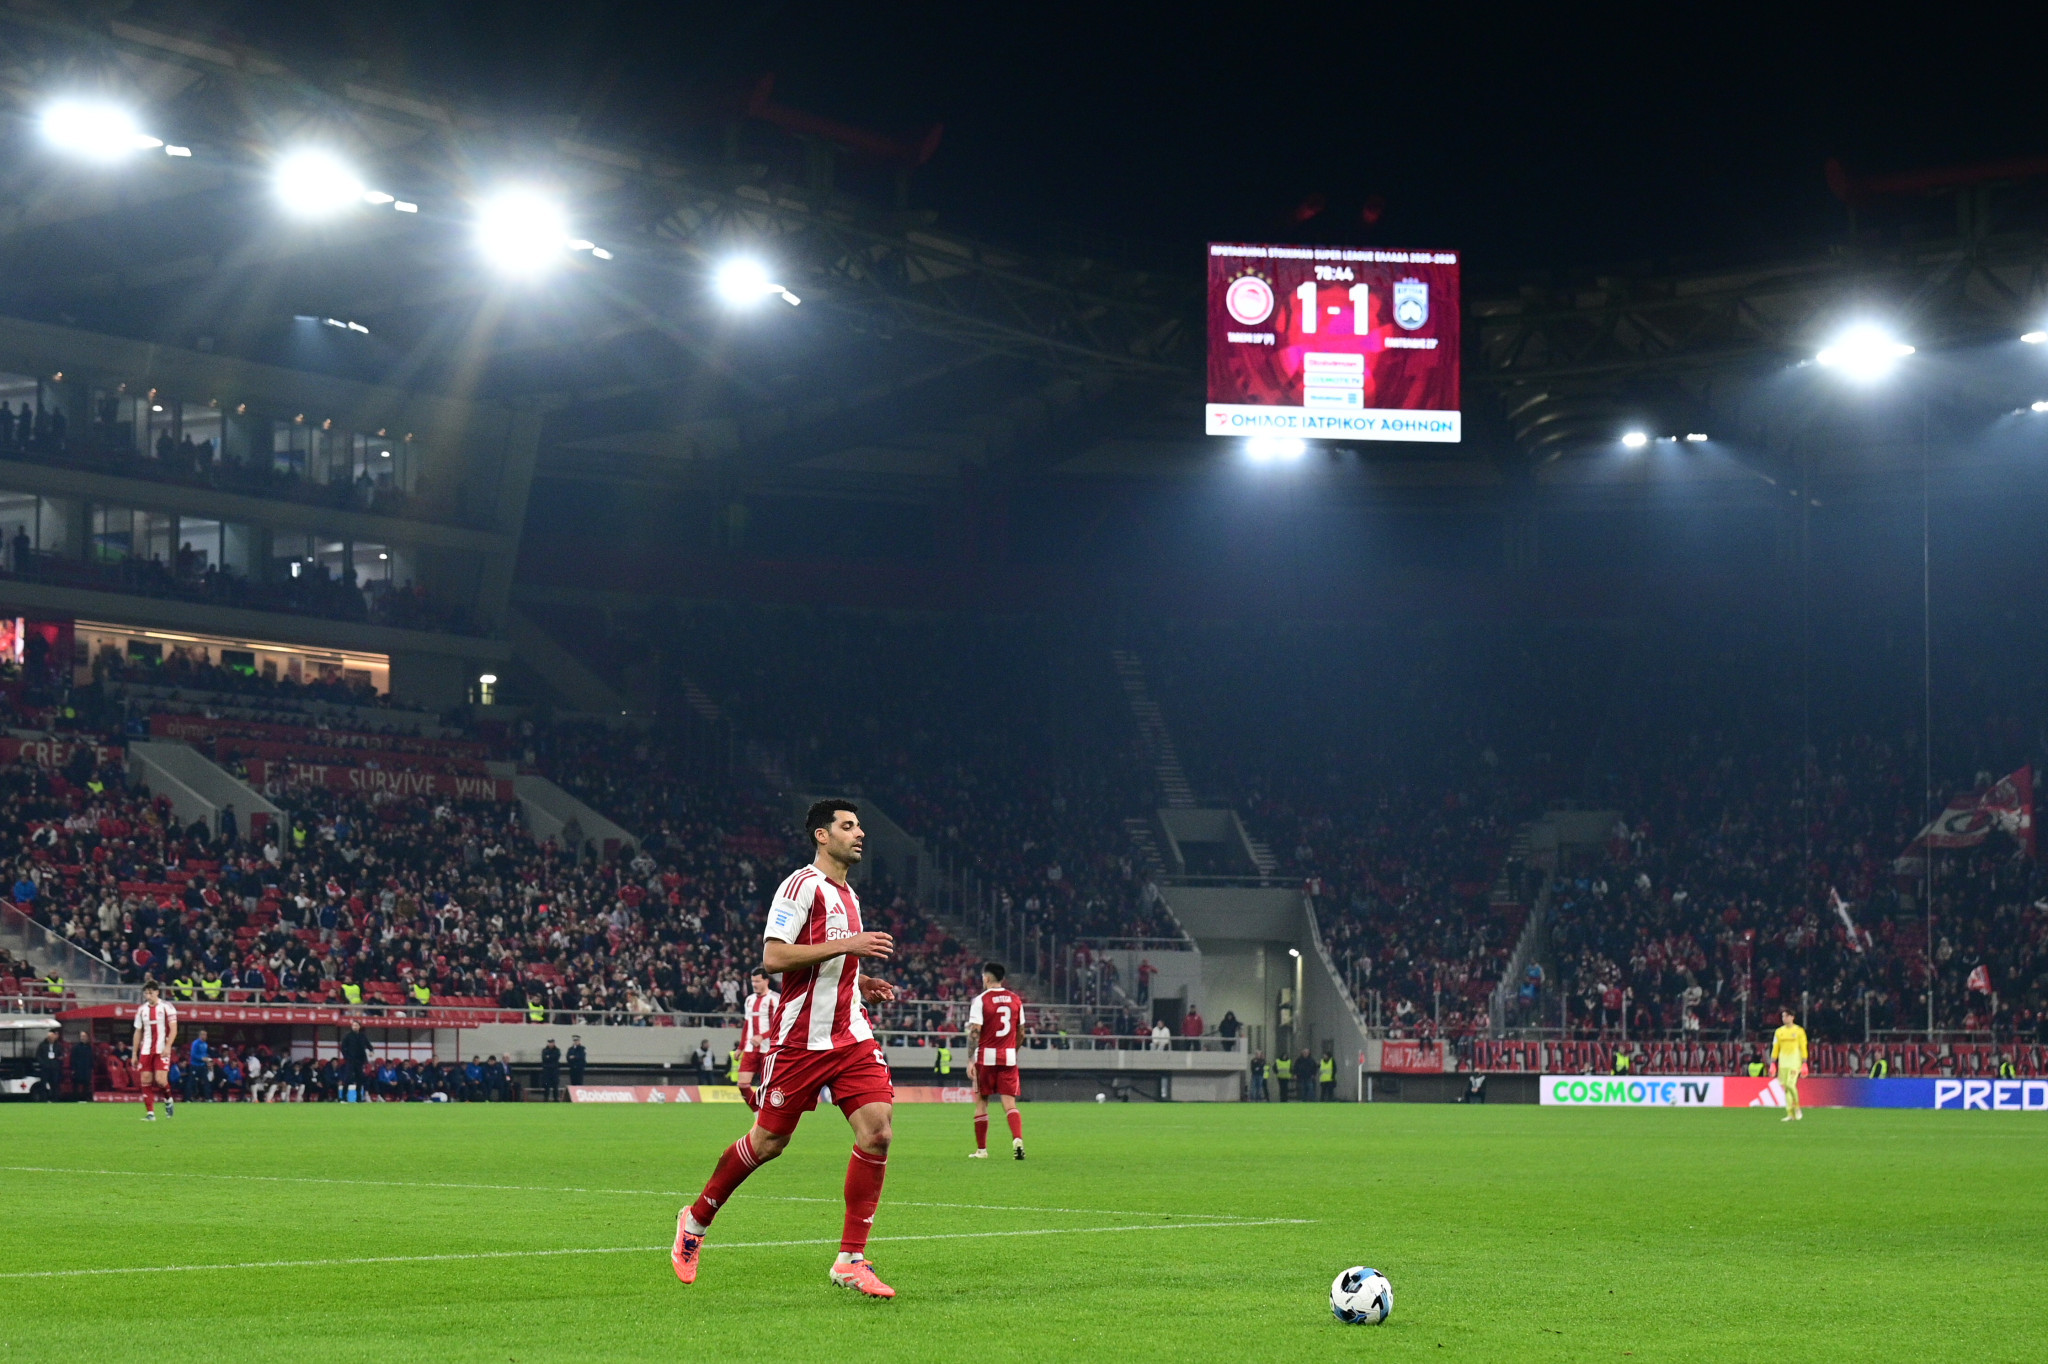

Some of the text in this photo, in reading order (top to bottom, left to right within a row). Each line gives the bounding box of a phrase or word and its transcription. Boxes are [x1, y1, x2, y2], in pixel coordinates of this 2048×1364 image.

[1297, 281, 1317, 334] 1
[1349, 283, 1369, 335] 1
[1231, 414, 1453, 432] ΟΜΙΛΟΣ ΙΑΤΡΙΚΟΥ ΑΘΗΝΩΝ
[20, 742, 108, 768] CREE
[263, 762, 496, 800] FGHT SURVIVE WIN
[995, 1005, 1011, 1037] 3
[1552, 1081, 1709, 1103] COSMOTE TV
[1934, 1079, 2048, 1111] PRED
